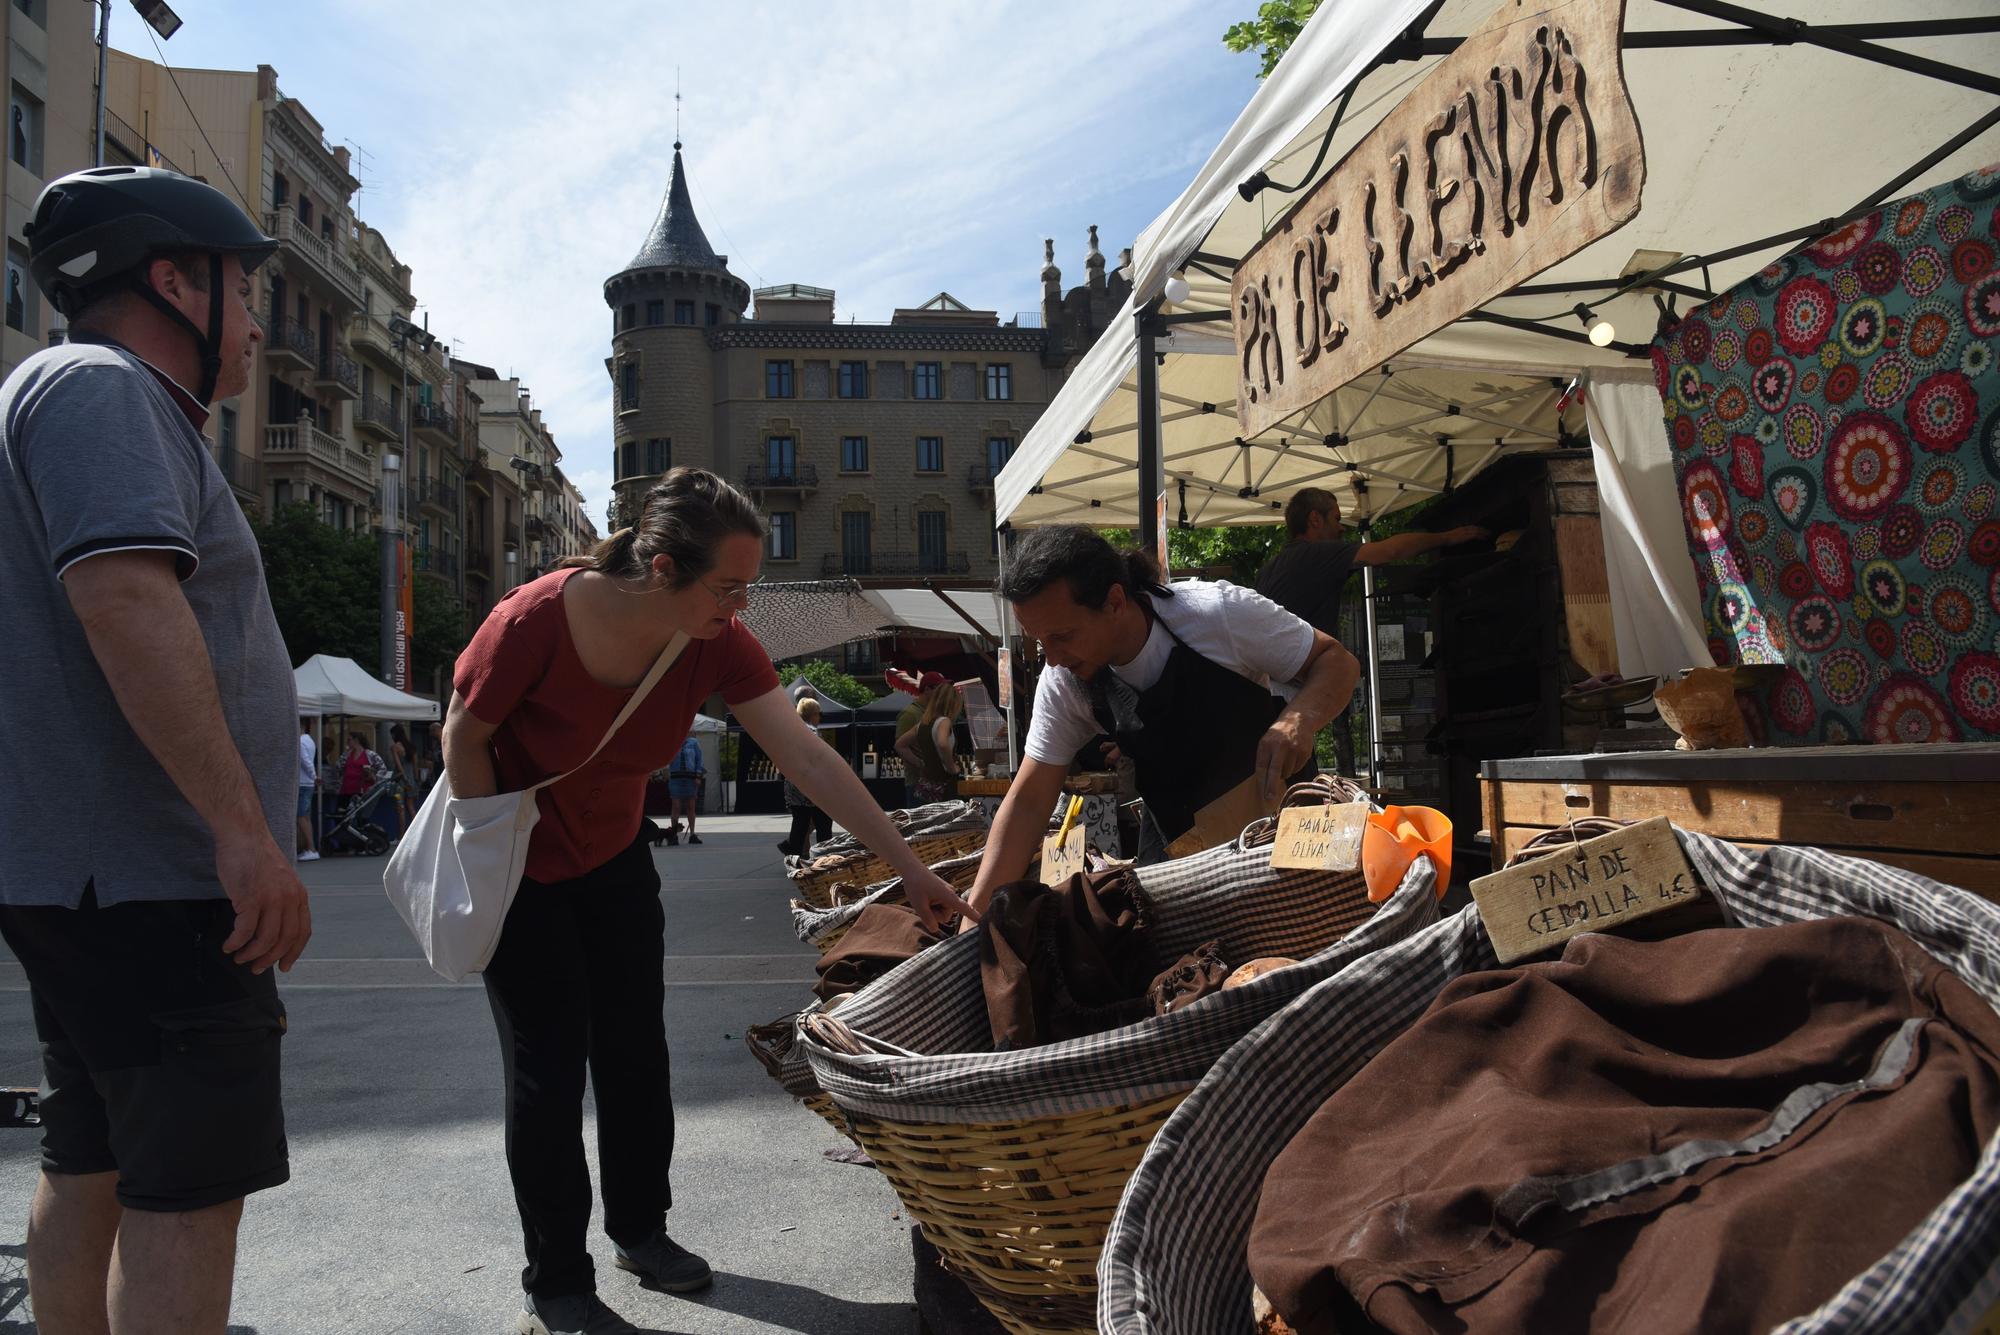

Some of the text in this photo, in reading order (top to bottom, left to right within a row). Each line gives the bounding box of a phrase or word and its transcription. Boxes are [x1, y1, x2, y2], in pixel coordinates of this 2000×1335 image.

[1241, 273, 1284, 404] PA
[1293, 207, 1349, 370] DE
[1297, 817, 1336, 834] PAN DE
[1530, 847, 1632, 900] PAN DE
